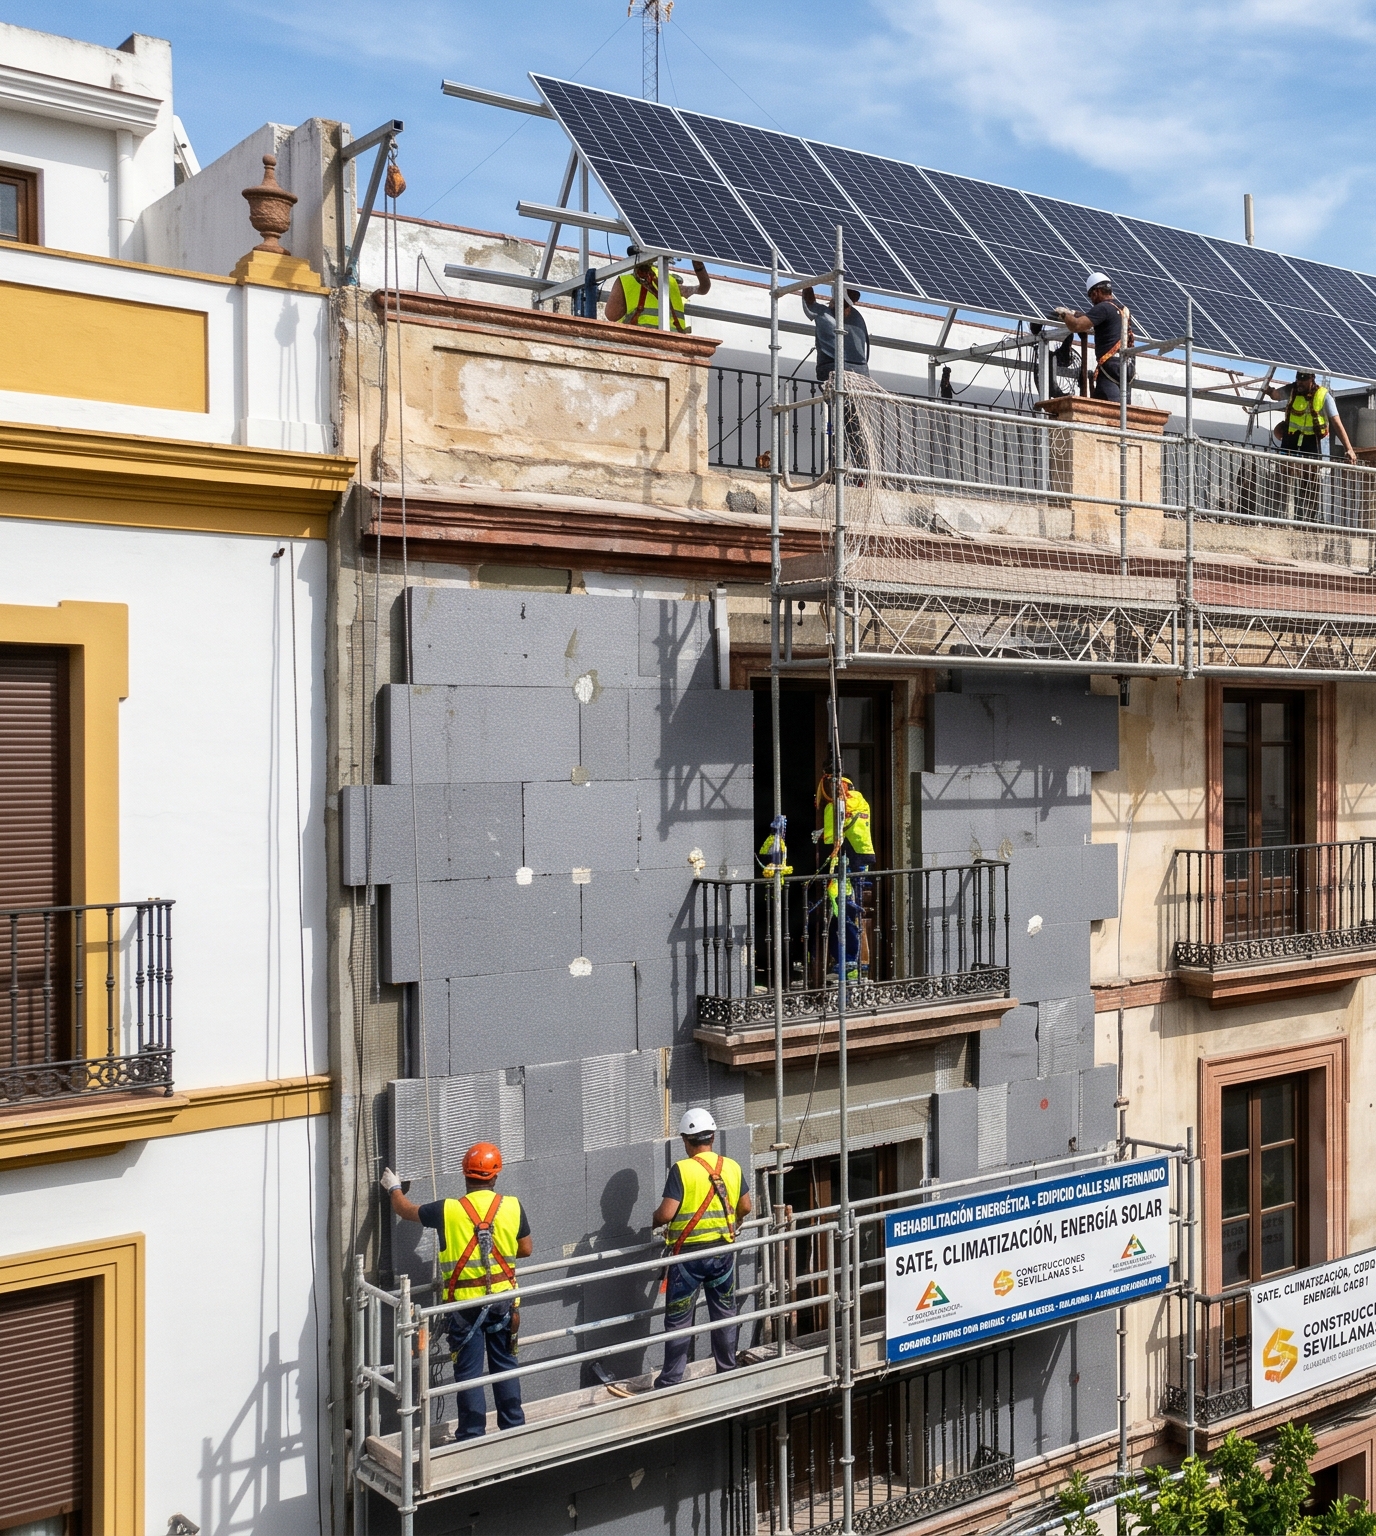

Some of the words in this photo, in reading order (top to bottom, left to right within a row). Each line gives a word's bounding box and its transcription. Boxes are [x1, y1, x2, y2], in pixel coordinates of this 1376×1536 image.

[894, 1204, 973, 1238] REHABILITACIÓN
[975, 1194, 1030, 1220] ENERGÉTICA
[1076, 1180, 1102, 1200] CALLE
[1103, 1174, 1121, 1193] SAN
[1122, 1167, 1165, 1189] FERNANDO
[895, 1250, 938, 1277] SATE,
[943, 1220, 1057, 1266] CLIMATIZACIÓN,
[1061, 1205, 1118, 1239] ENERGÍA
[1121, 1198, 1162, 1224] SOLAR
[1018, 1267, 1070, 1288] SEVILLANAS
[1072, 1264, 1084, 1274] S.L
